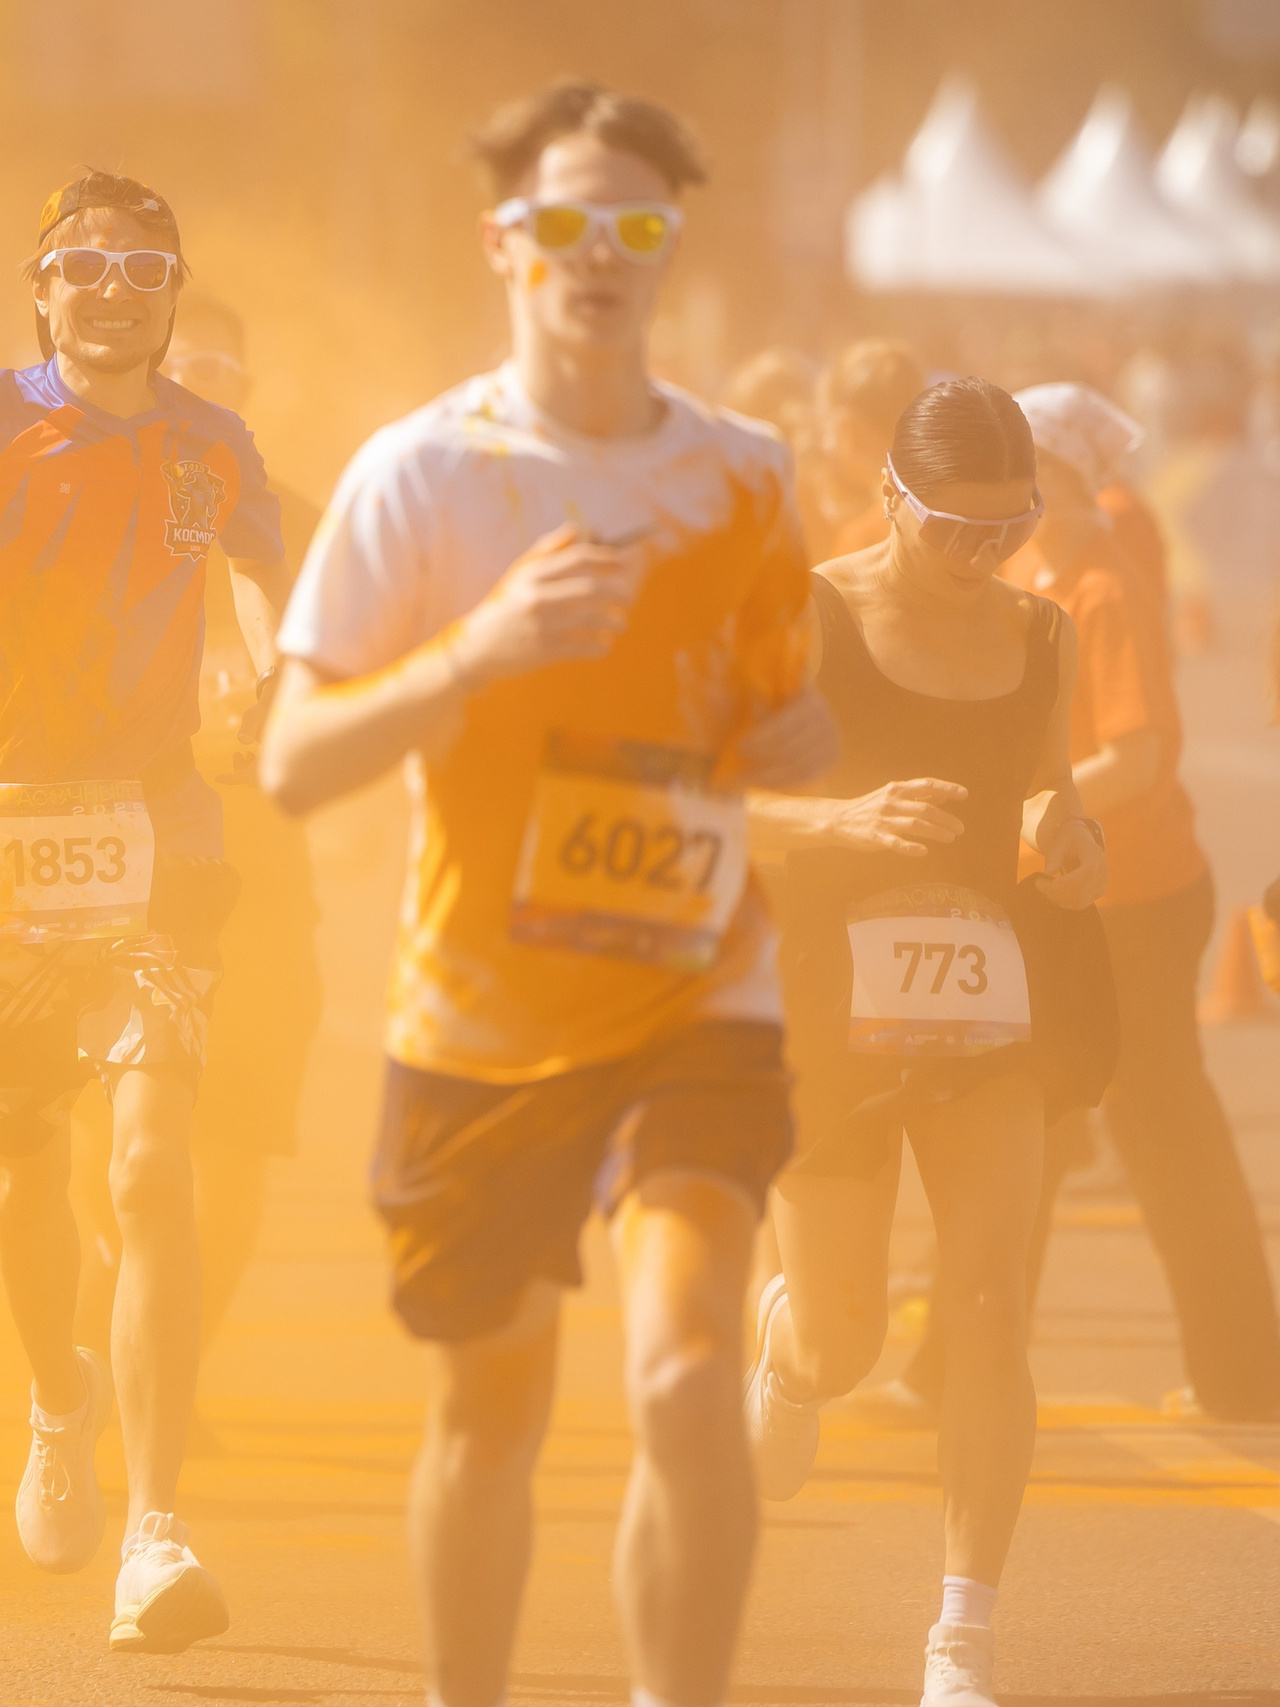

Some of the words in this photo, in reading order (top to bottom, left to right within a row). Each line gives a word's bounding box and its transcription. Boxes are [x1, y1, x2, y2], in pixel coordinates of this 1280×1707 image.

[4, 836, 127, 888] 1853
[557, 810, 724, 896] 6027
[893, 941, 988, 996] 773
